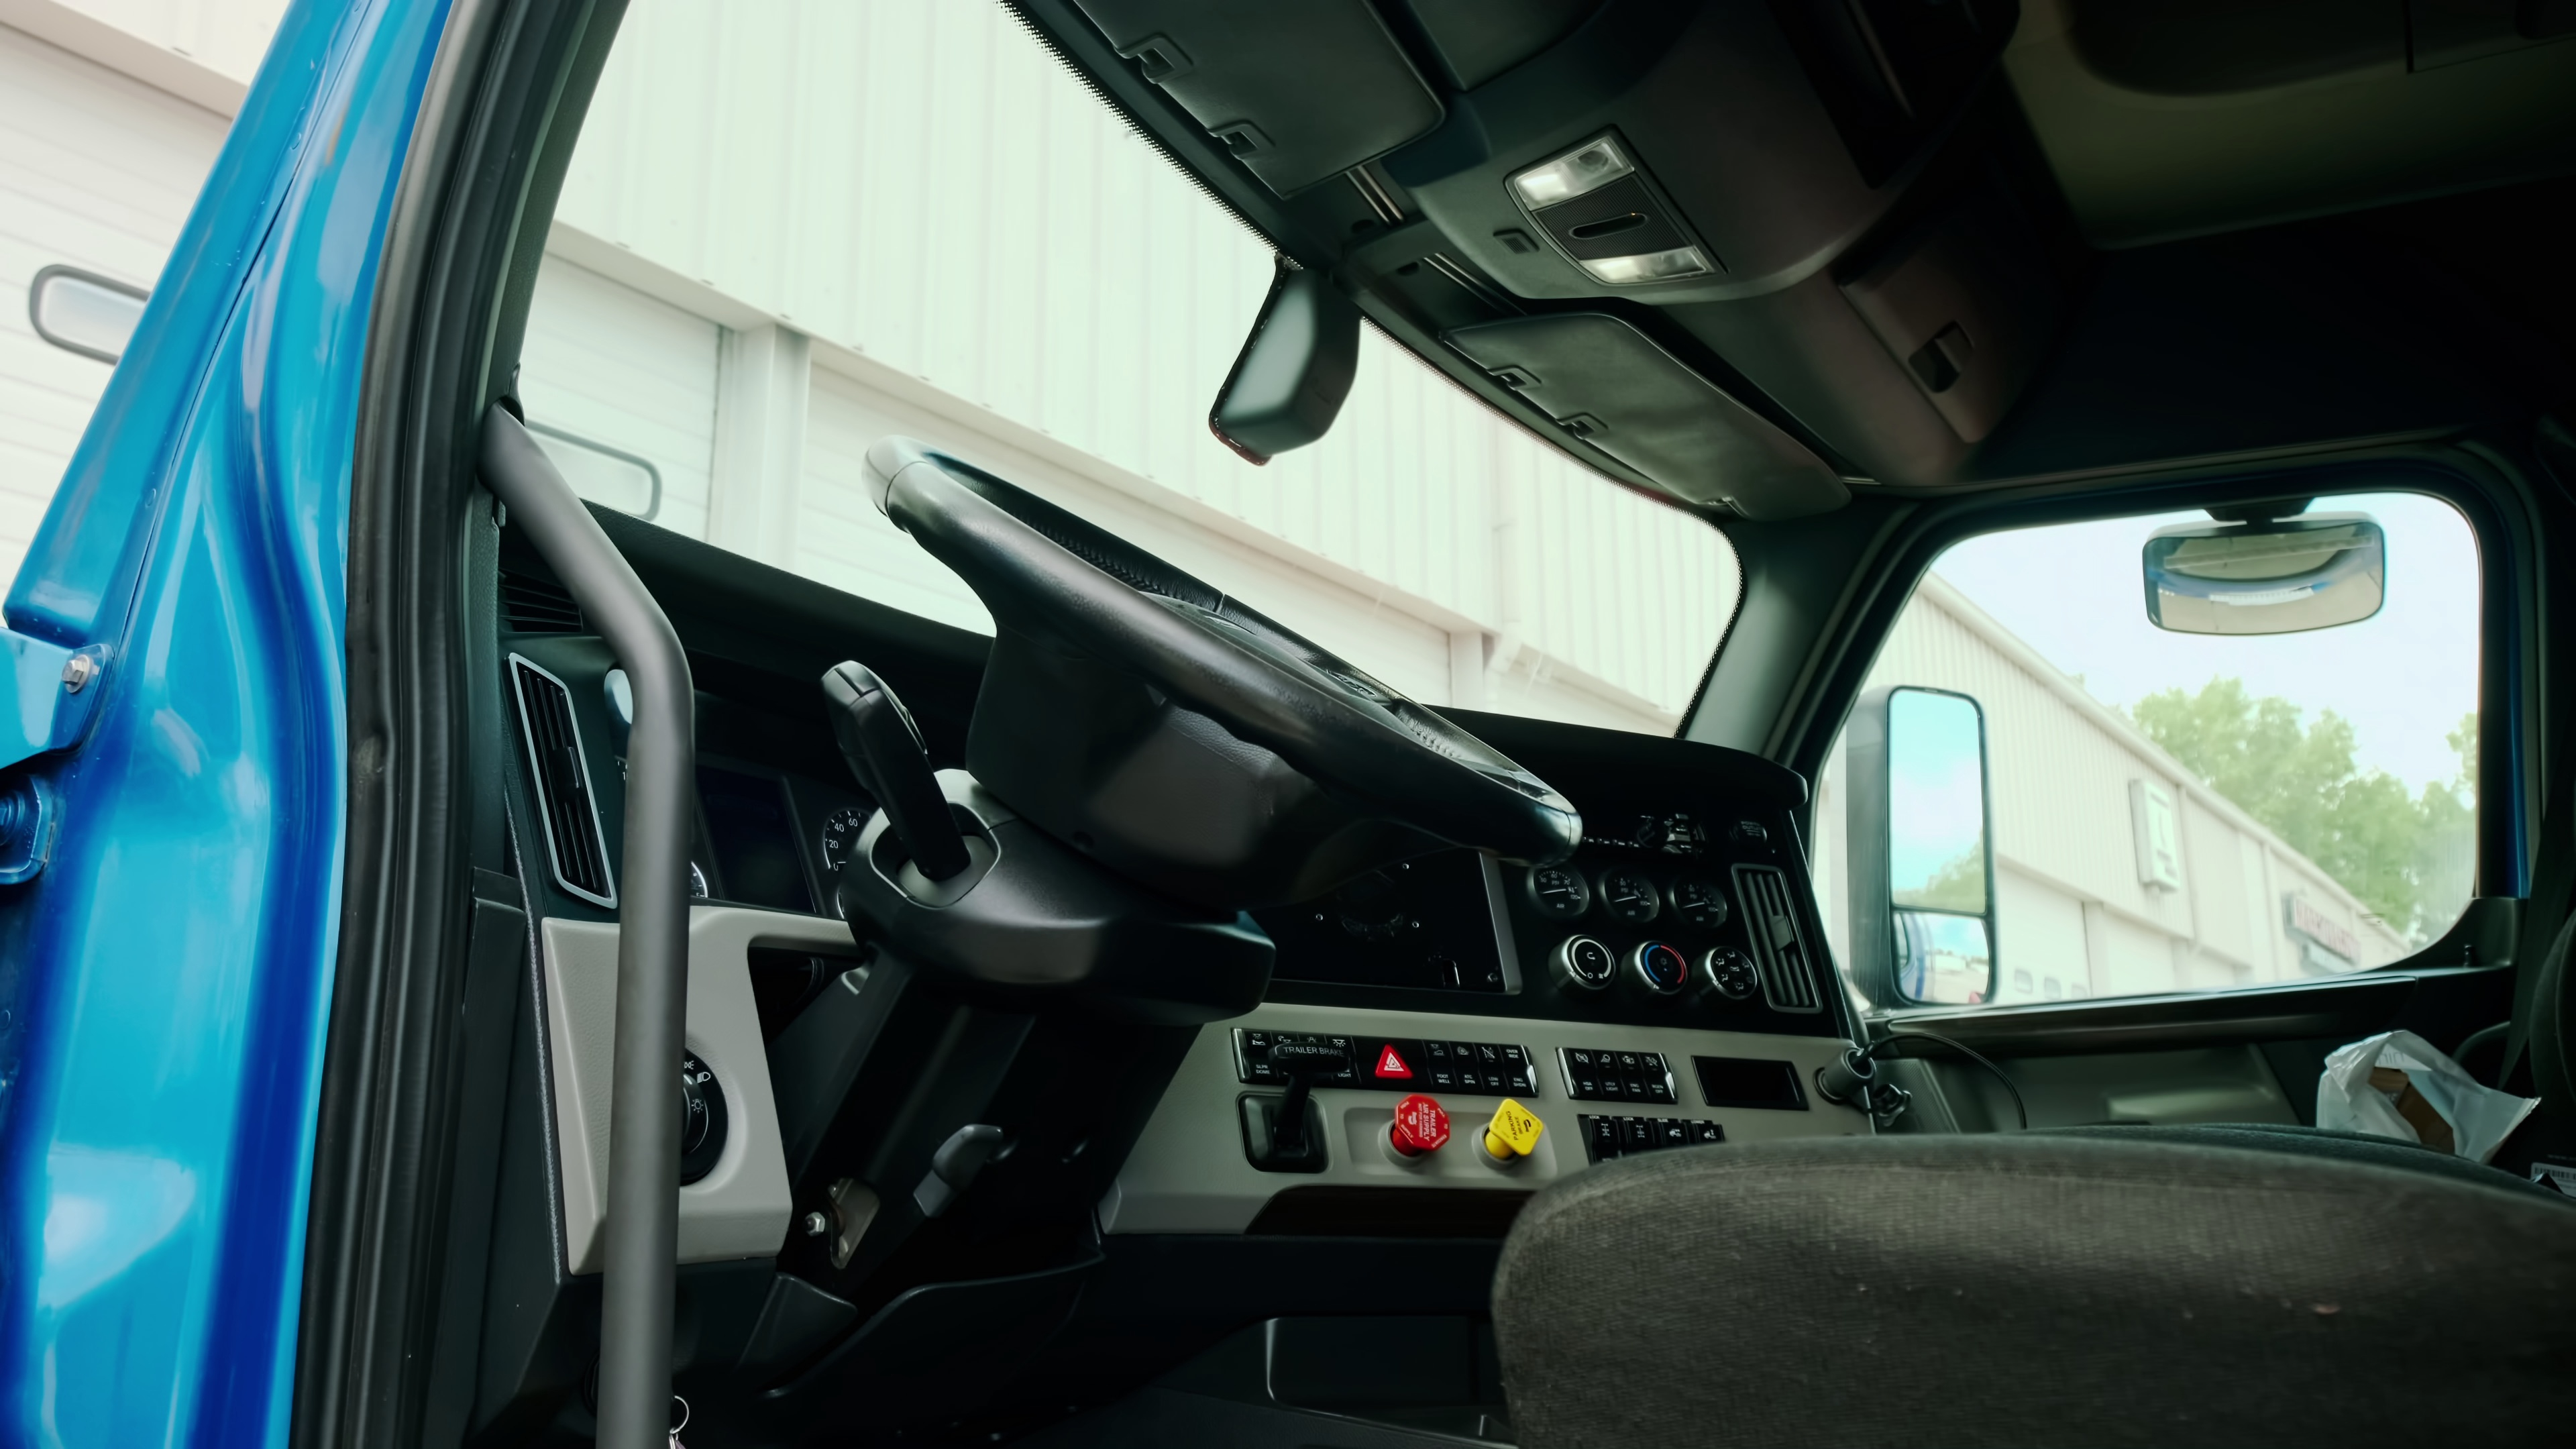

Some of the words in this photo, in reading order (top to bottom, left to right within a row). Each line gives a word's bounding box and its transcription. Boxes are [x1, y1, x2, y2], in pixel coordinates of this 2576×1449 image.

[849, 818, 857, 826] 60
[835, 823, 845, 832] 40
[828, 839, 839, 849] 20
[1283, 1046, 1318, 1055] TRAILER
[1319, 1047, 1344, 1057] BRAKE
[1505, 1110, 1519, 1140] PARKING
[1514, 1116, 1523, 1135] BRAKE
